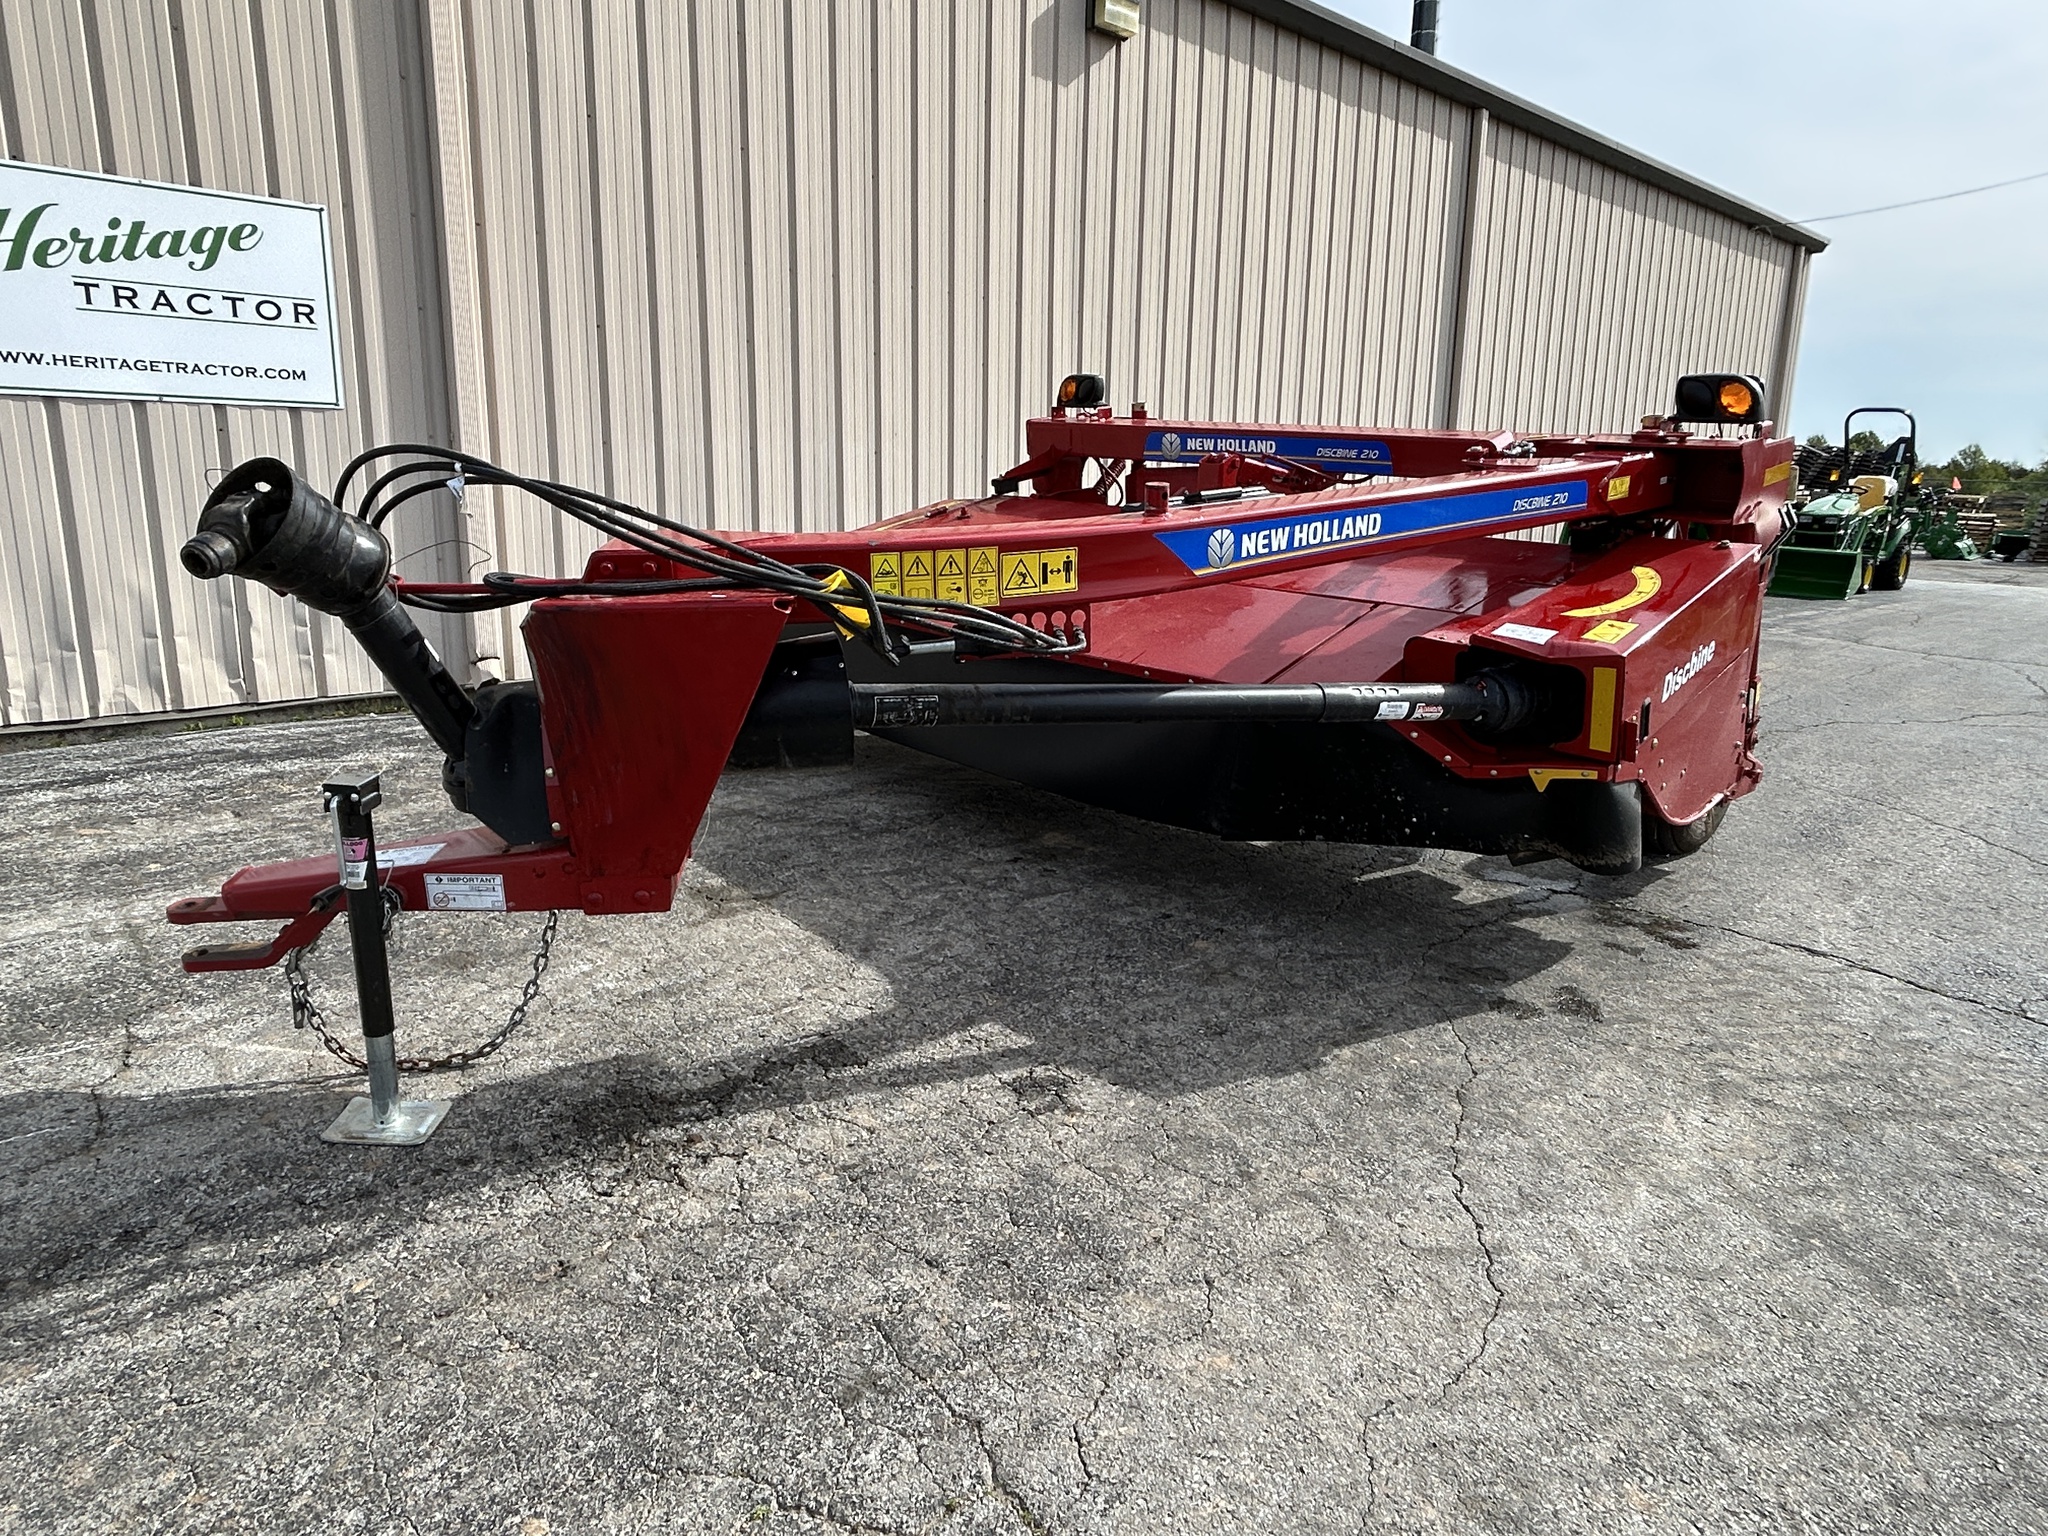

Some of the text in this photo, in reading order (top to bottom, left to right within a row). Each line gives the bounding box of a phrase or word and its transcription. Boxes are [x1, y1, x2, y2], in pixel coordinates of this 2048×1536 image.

[0, 203, 264, 271] Heritage
[73, 280, 318, 325] TRACTOR
[1187, 438, 1276, 454] NEW HOLLAND
[1316, 447, 1380, 459] DISCBINE 210
[1512, 492, 1569, 512] DISCBINE 210
[1241, 513, 1381, 558] NEW HOLLAND
[1661, 640, 1716, 704] Discbine
[446, 876, 496, 884] IMPORTANT
